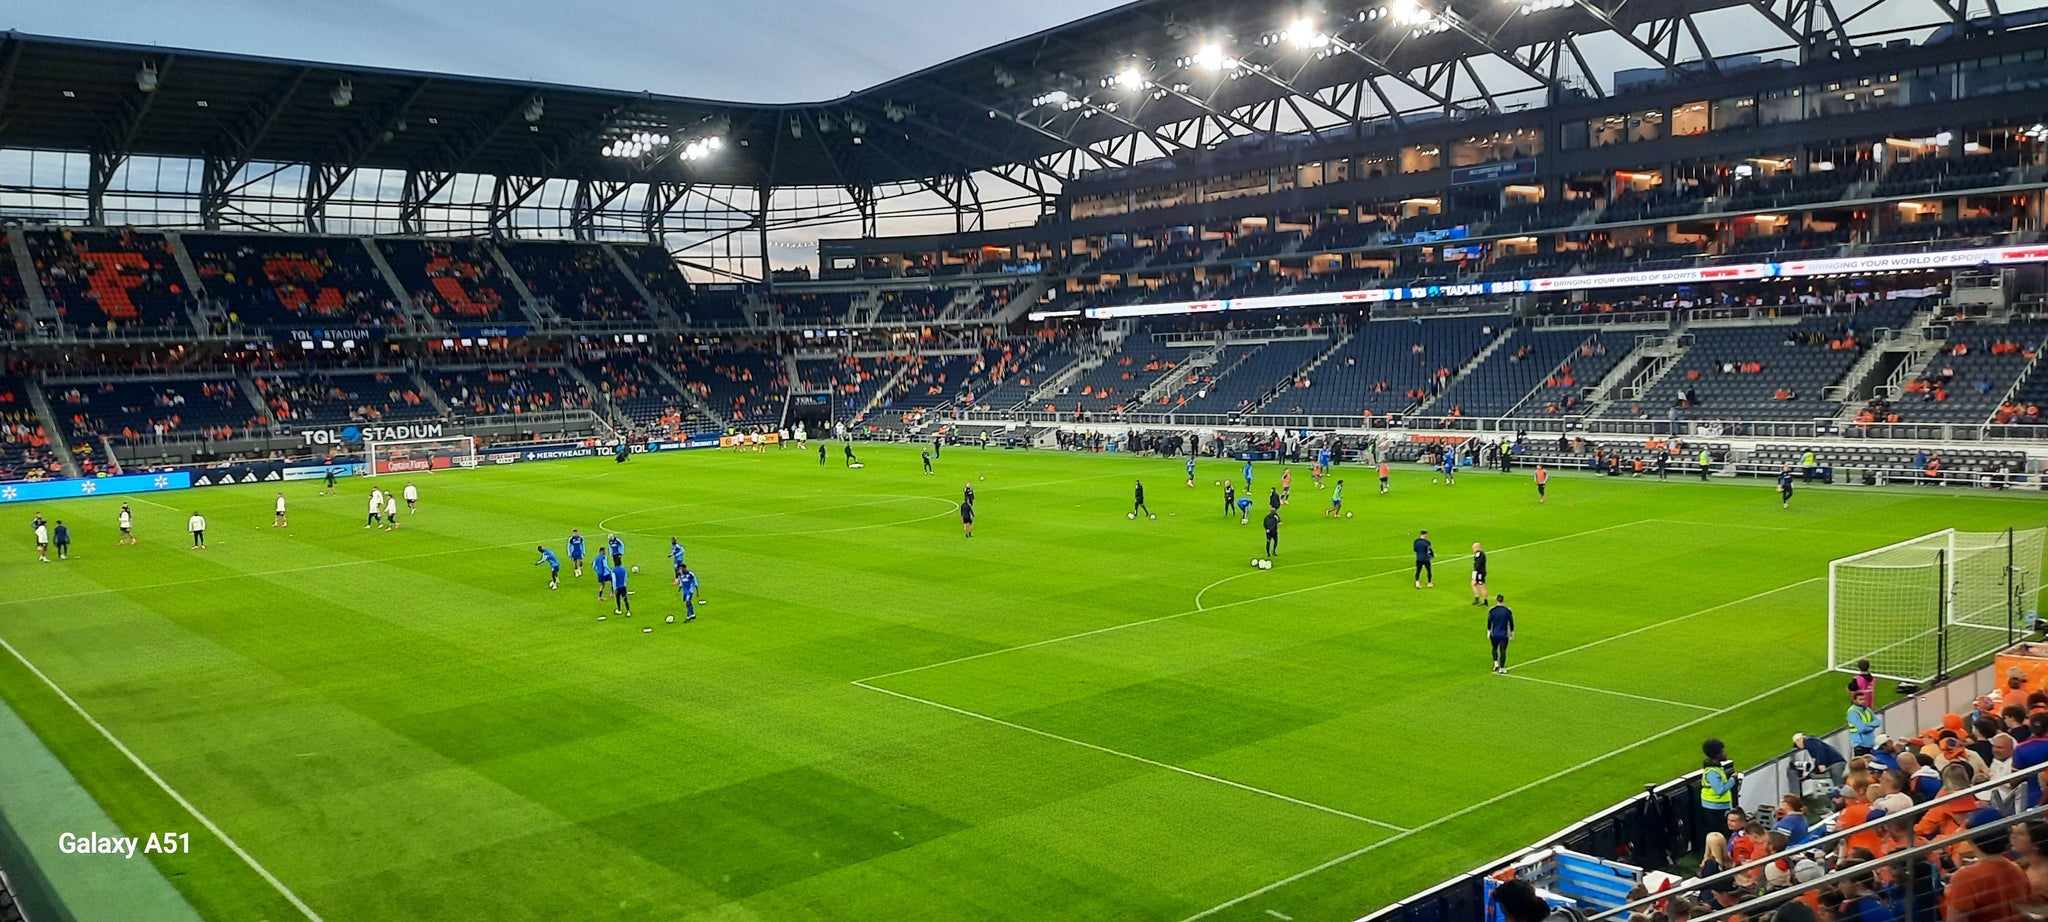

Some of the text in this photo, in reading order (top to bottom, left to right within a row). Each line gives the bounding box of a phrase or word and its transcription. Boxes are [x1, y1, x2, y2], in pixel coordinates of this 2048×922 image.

[1807, 261, 1859, 272] BRINGING
[1860, 259, 1889, 269] YOUR
[1890, 256, 1931, 267] WORLD
[1932, 255, 1949, 265] OF
[1553, 279, 1592, 288] BRINGING
[1593, 277, 1616, 285] YOUR
[1616, 275, 1648, 283] WORLD
[1661, 271, 1698, 280] SPORTS
[291, 329, 370, 340] TQL STADIUM
[301, 424, 443, 445] TQL STADIUM
[536, 449, 592, 459] MERCYHEALTH
[596, 447, 616, 456] TQL
[629, 444, 649, 454] TQL
